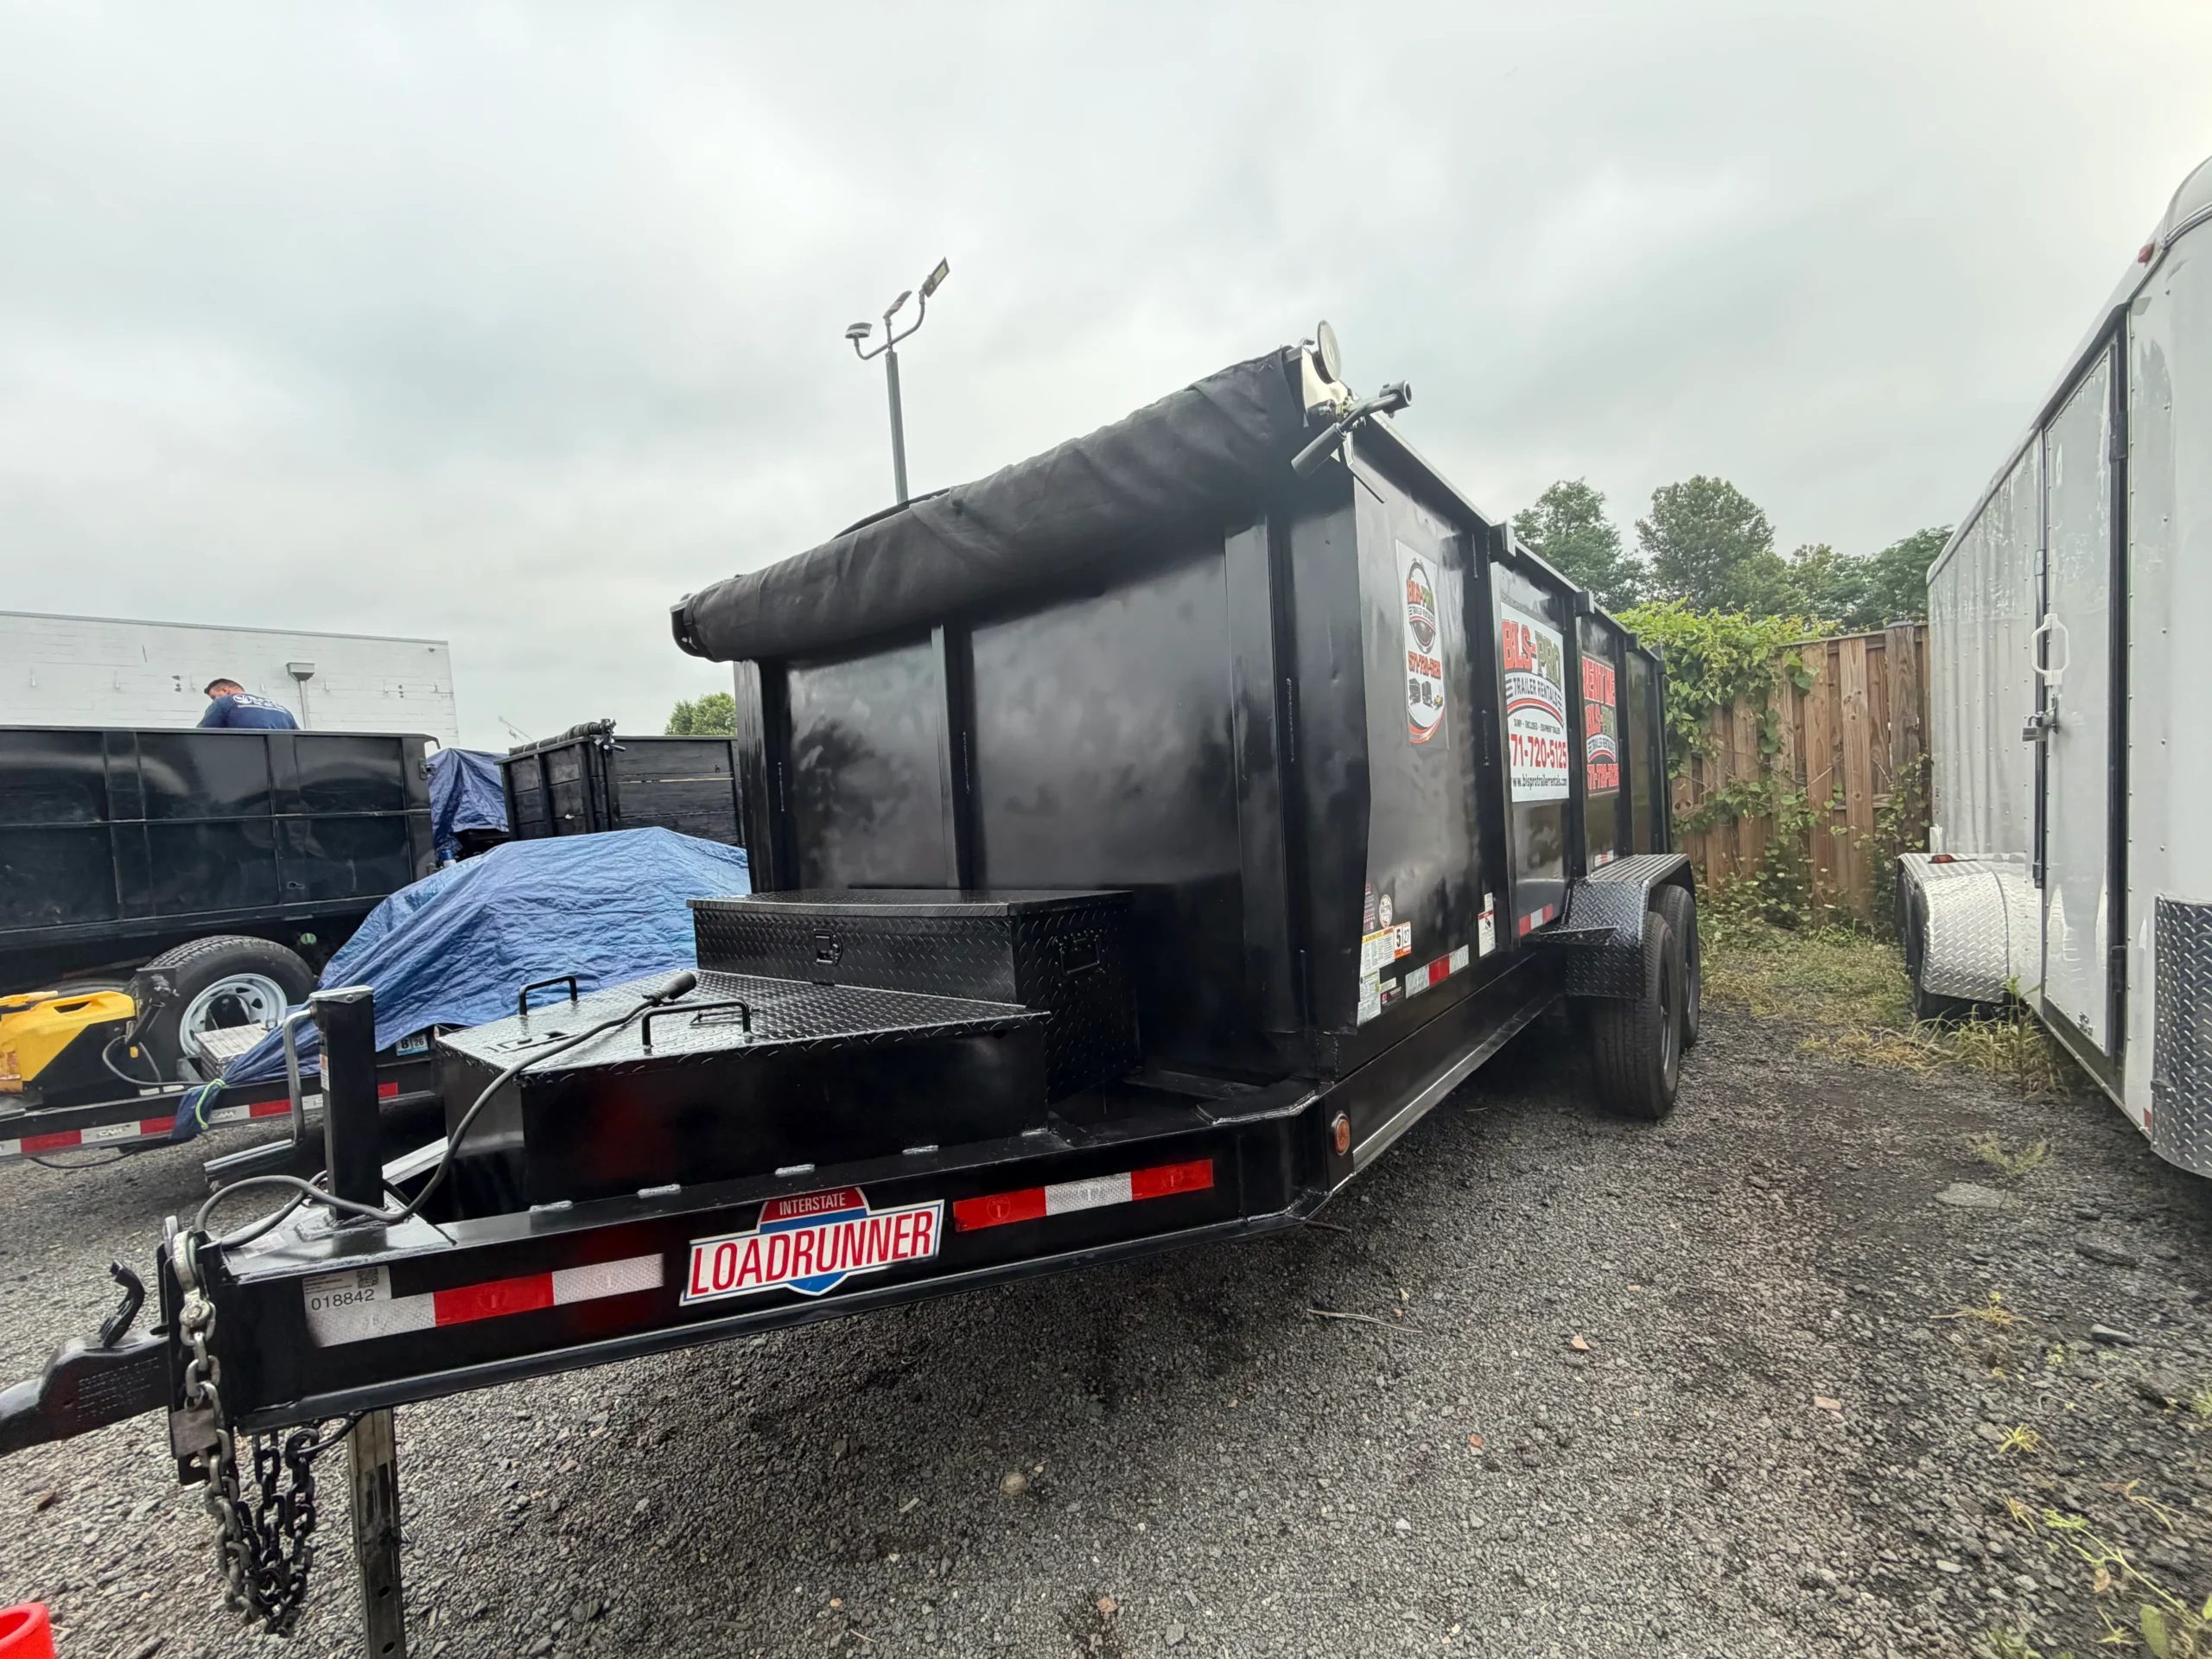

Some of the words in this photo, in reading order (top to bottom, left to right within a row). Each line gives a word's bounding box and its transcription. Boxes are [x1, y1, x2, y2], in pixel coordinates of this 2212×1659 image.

[1407, 579, 1434, 611] BLS-PRO
[1502, 619, 1561, 691] BLS-PRO
[1513, 677, 1537, 696] TRAILER
[1537, 681, 1558, 707] RENTALS
[1582, 656, 1605, 702] RENT
[1605, 666, 1616, 707] ME
[1396, 929, 1402, 948] 5
[401, 1039, 410, 1049] 8
[414, 1038, 424, 1047] 26
[779, 1192, 846, 1217] INTERSTATE
[691, 1211, 933, 1295] LOADRUNNER
[311, 1288, 375, 1311] 018842
